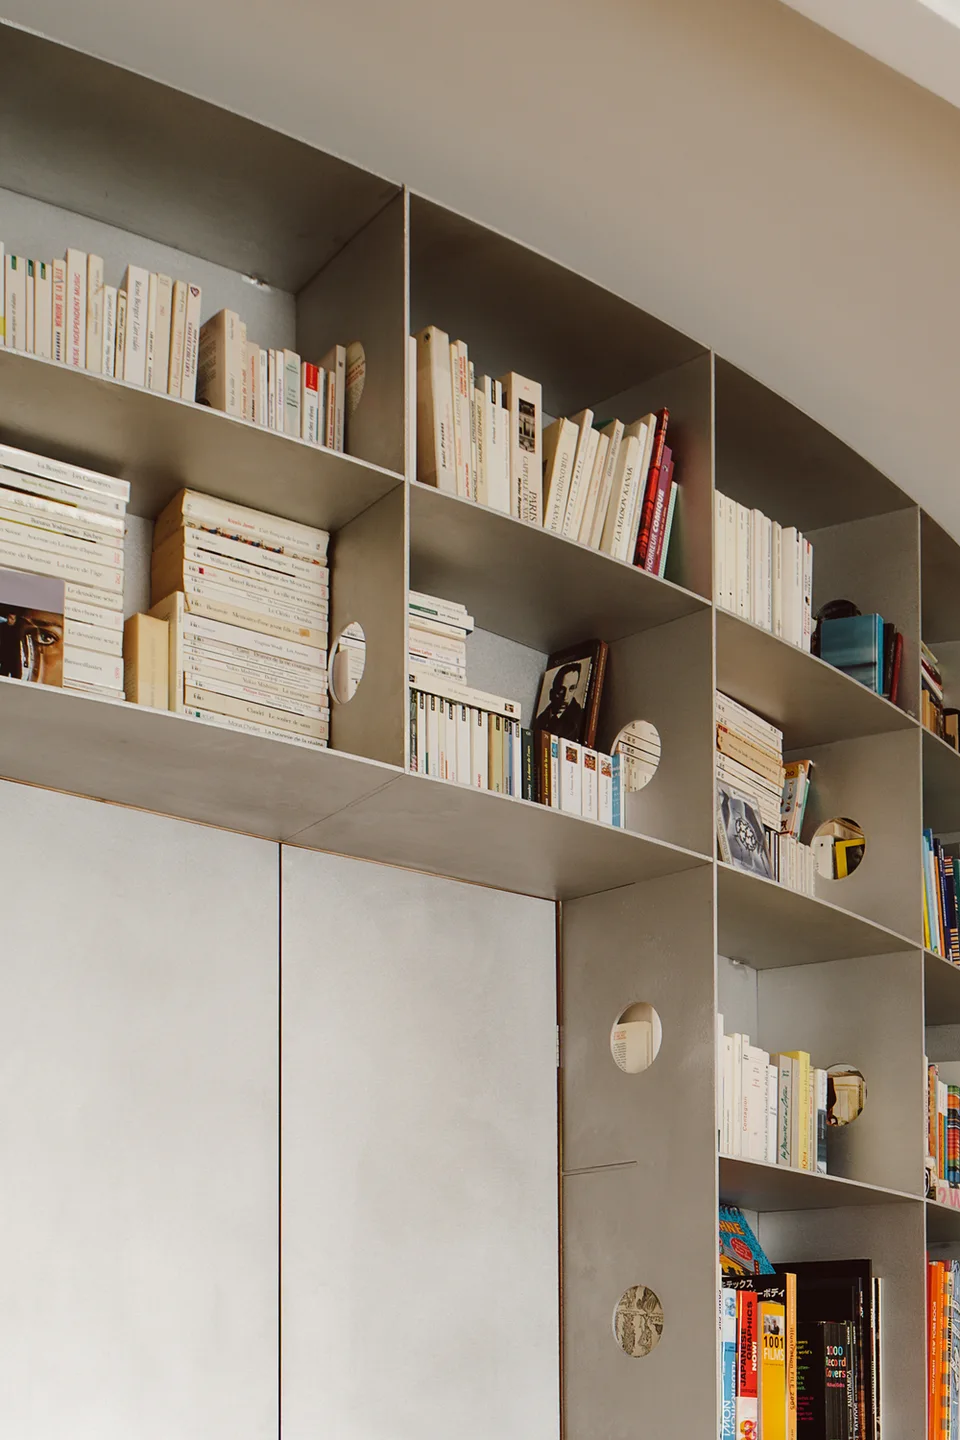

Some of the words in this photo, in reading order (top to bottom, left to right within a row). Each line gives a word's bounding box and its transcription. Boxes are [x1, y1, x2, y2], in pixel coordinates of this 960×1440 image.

[554, 452, 569, 503] CHRONIQUES
[622, 465, 633, 496] KANAK
[529, 491, 537, 522] PARIS
[616, 496, 628, 530] MAISON
[653, 488, 665, 533] COMIQUE
[550, 504, 560, 532] KANAK
[614, 530, 622, 542] LA
[763, 1335, 784, 1348] 1001
[826, 1345, 844, 1357] 1000
[763, 1348, 784, 1362] FILMS
[825, 1357, 847, 1368] Record
[825, 1367, 846, 1379] Covers
